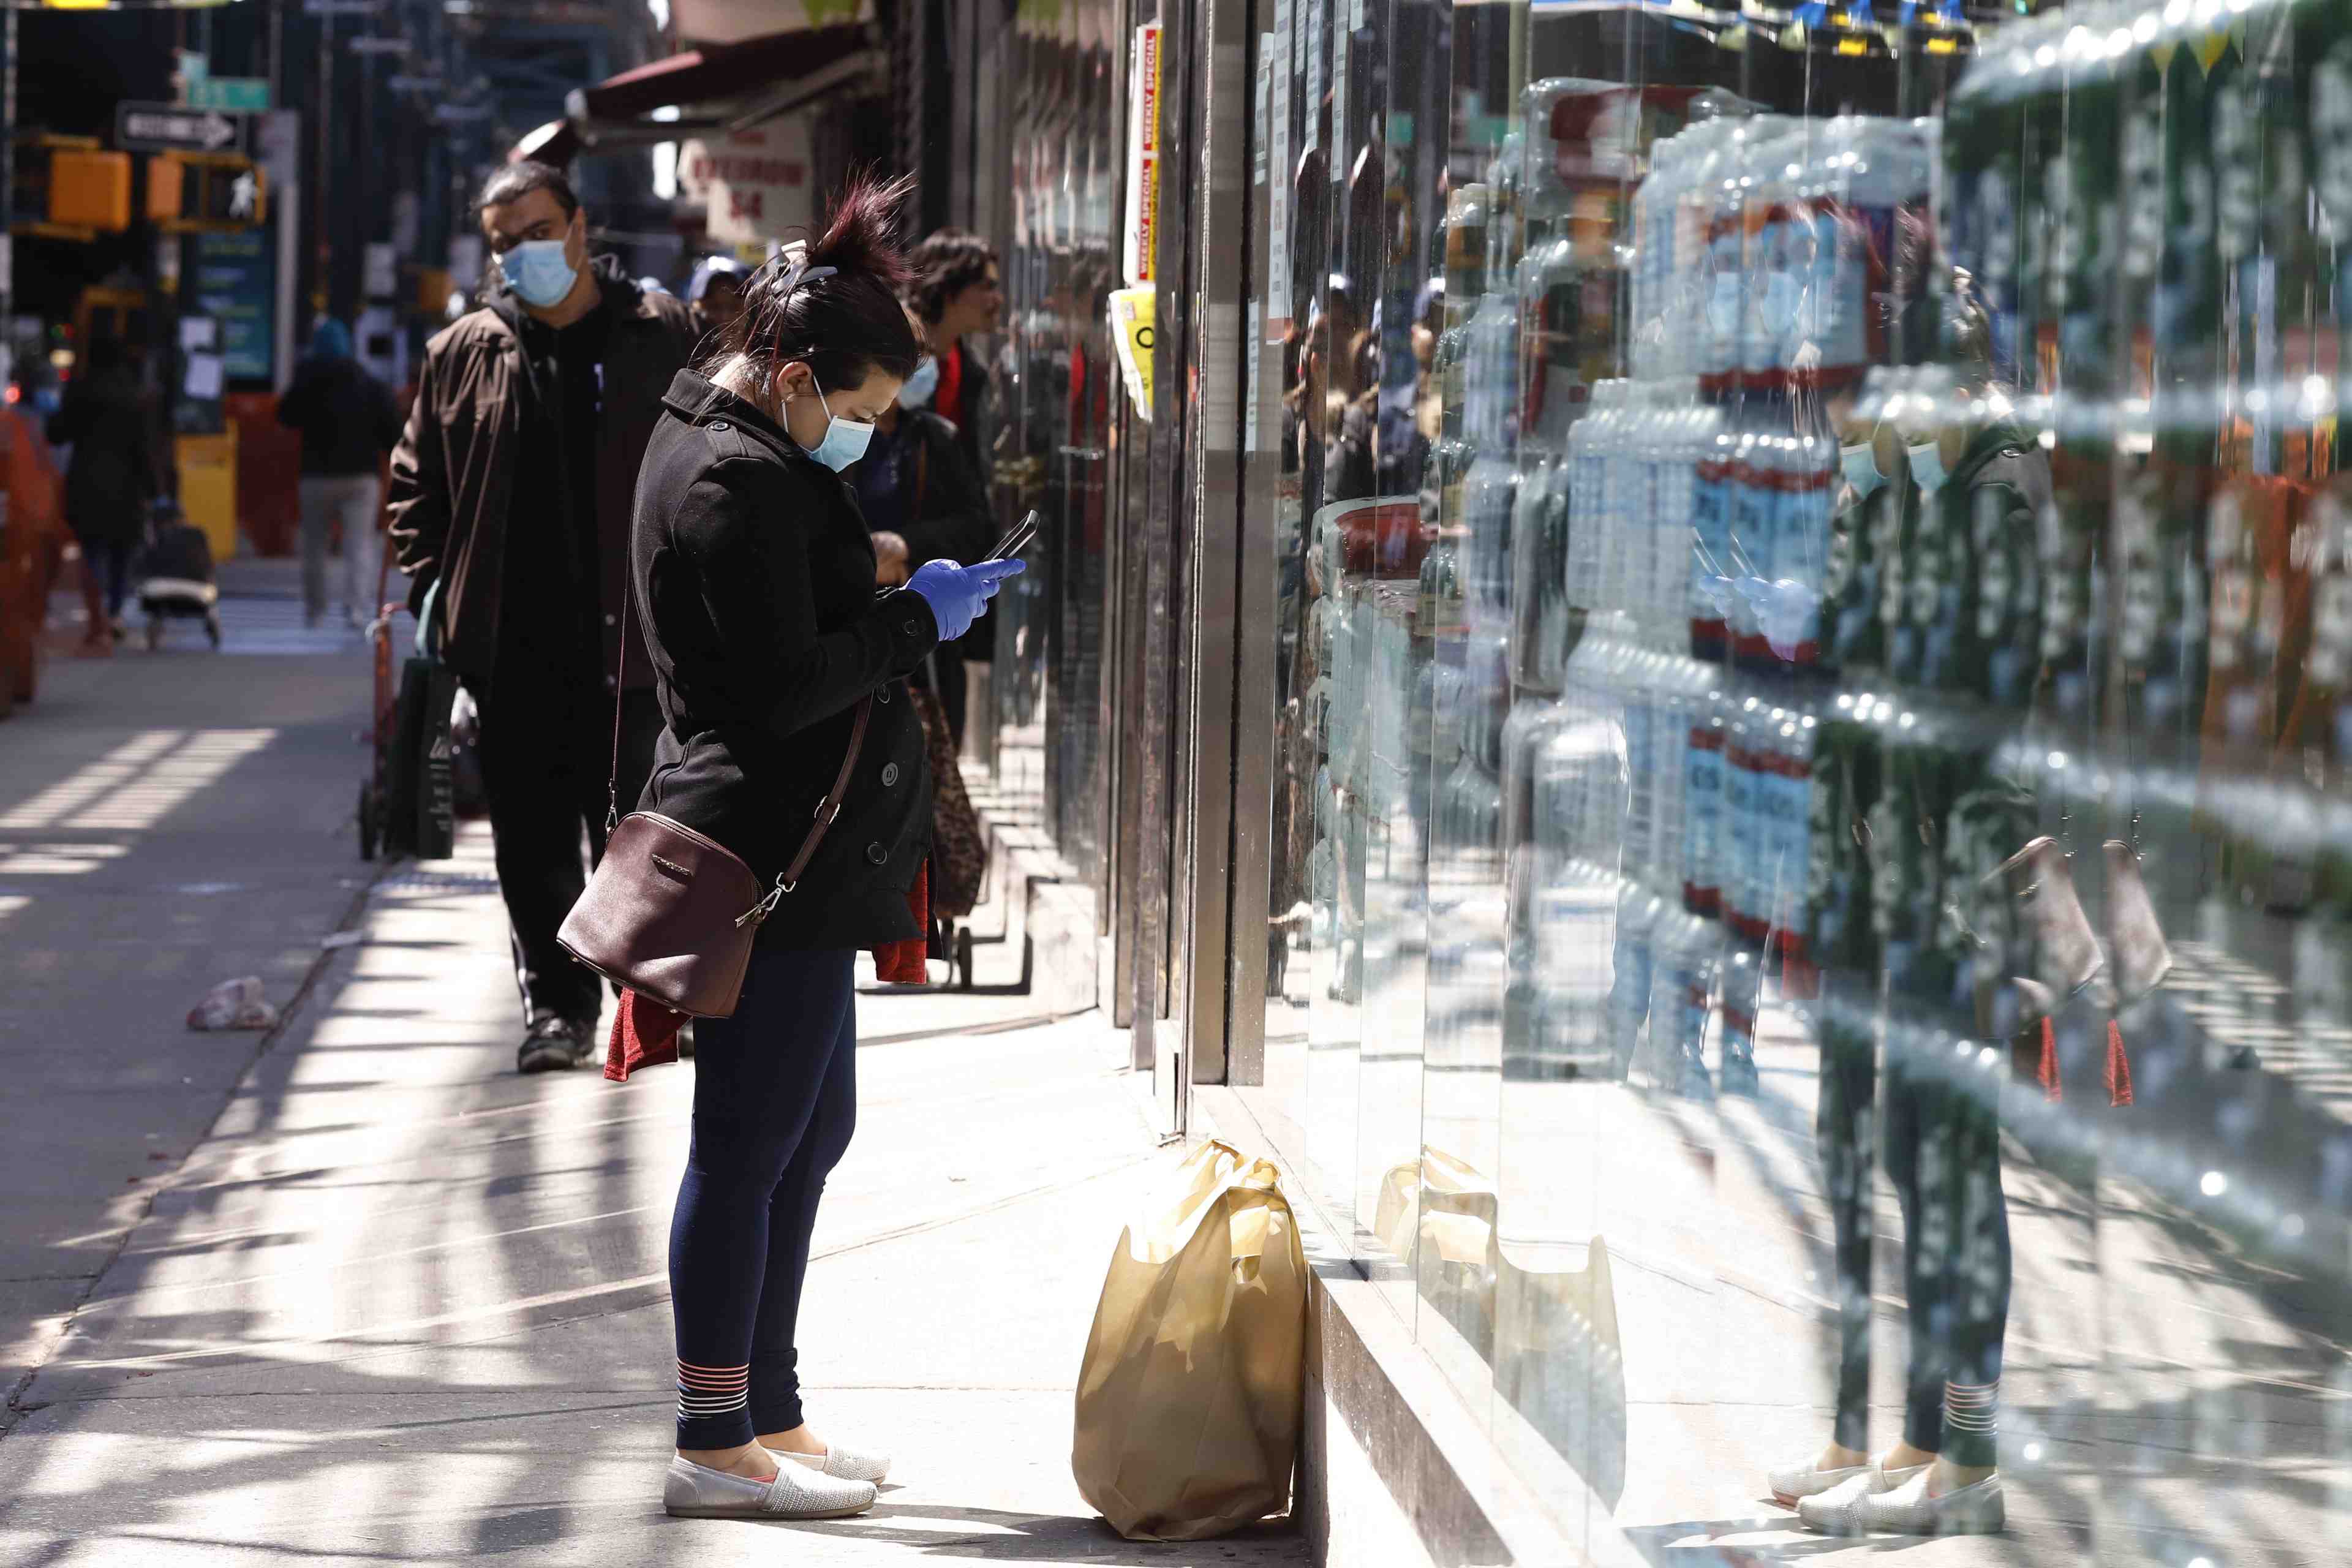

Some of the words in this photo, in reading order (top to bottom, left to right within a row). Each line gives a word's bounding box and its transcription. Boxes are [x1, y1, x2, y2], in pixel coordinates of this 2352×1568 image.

[1145, 37, 1156, 91] SPECIAL
[1144, 94, 1153, 145] WEEKLY
[1142, 167, 1152, 219] SPECIAL
[1140, 225, 1150, 273] WEEKLY
